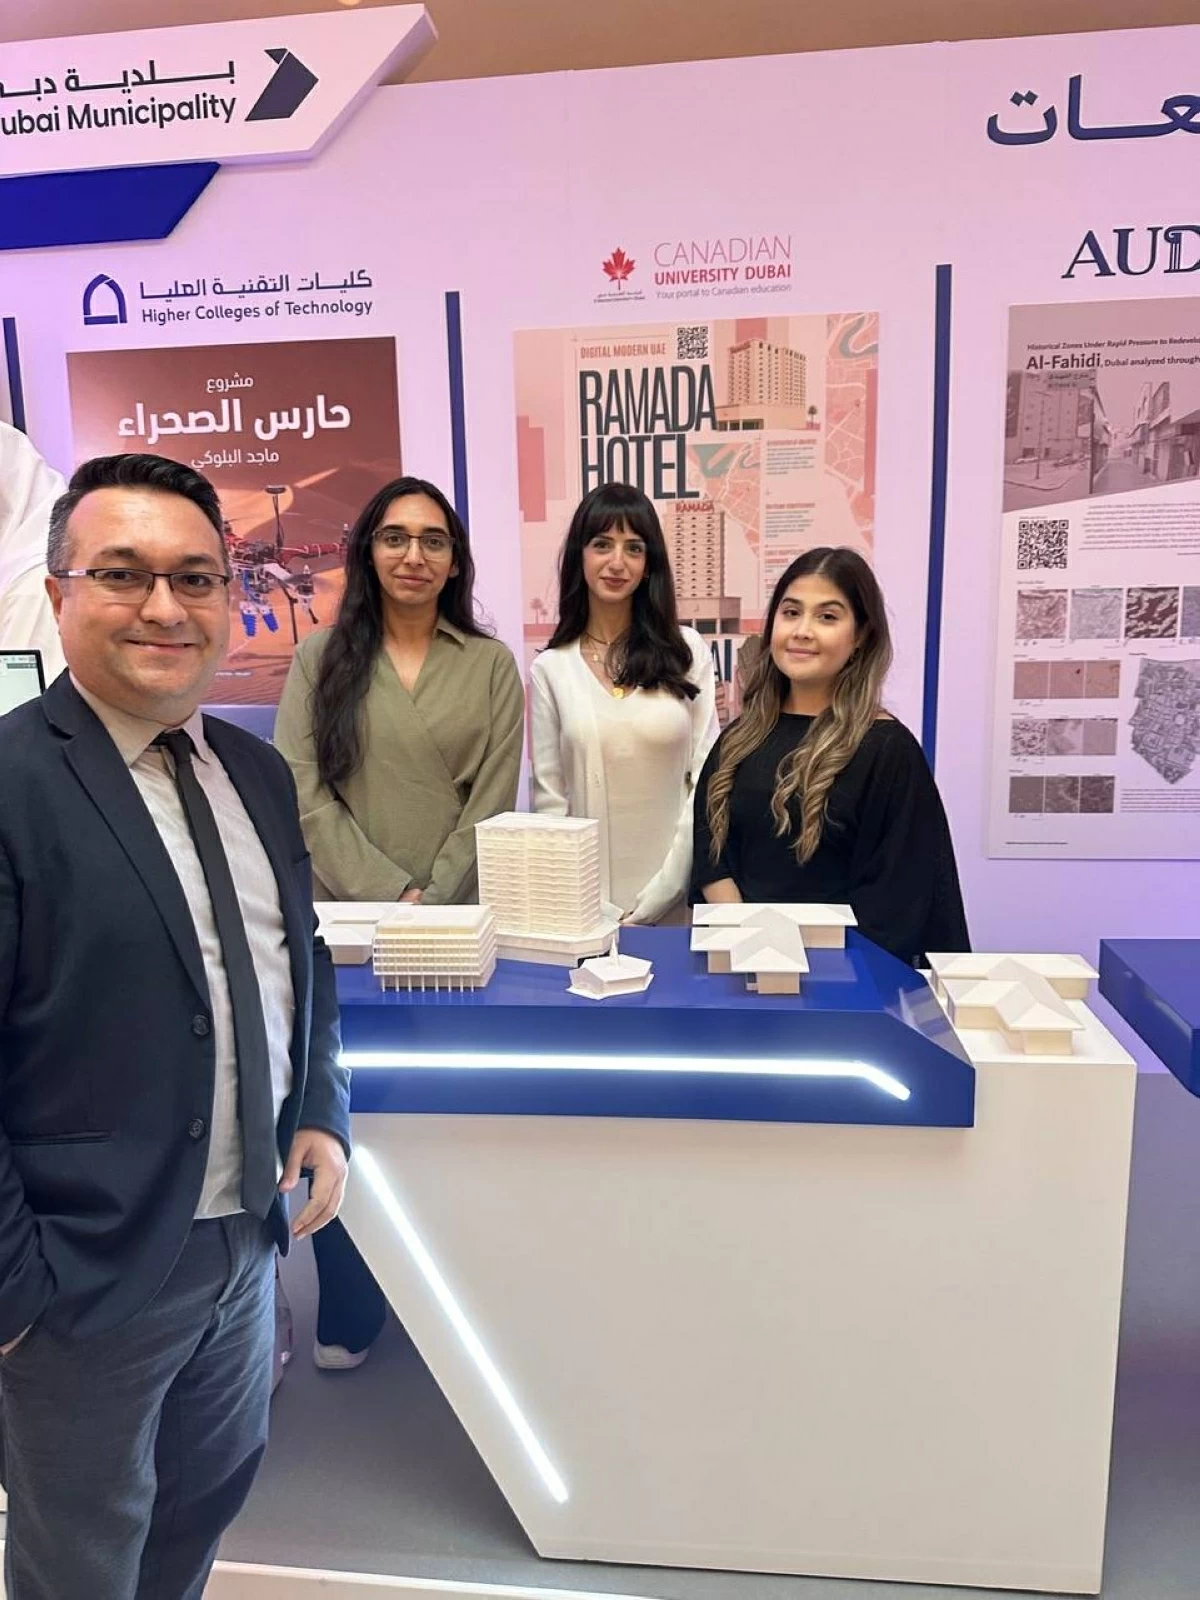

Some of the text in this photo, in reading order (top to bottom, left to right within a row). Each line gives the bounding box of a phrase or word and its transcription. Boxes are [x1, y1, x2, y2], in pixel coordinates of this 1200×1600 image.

[64, 59, 236, 95] بلدية
[0, 91, 237, 136] ubai Municipality
[987, 74, 1200, 145] عات
[653, 235, 792, 268] CANADIAN
[1060, 224, 1200, 279] AUD
[139, 268, 373, 302] كليات التقنية العليا
[654, 264, 792, 286] UNIVERSITY DUBAI
[655, 290, 676, 300] Your
[676, 287, 700, 300] portal
[701, 288, 711, 297] to
[711, 285, 749, 298] Canadian
[750, 283, 792, 295] education
[142, 299, 373, 326] Higher Colleges of Technology
[580, 342, 666, 360] DIGITAL MODERN UAE
[1084, 340, 1106, 349] Under
[1107, 339, 1127, 349] Rapid
[1128, 338, 1159, 347] Pressure
[1104, 358, 1129, 367] Dubai
[1130, 356, 1166, 368] analyzed
[206, 372, 254, 394] مشروع
[579, 364, 718, 436] RAMADA
[118, 394, 351, 445] حارس الصحراء
[246, 448, 280, 465] ماجد
[580, 433, 701, 500] HOTEL
